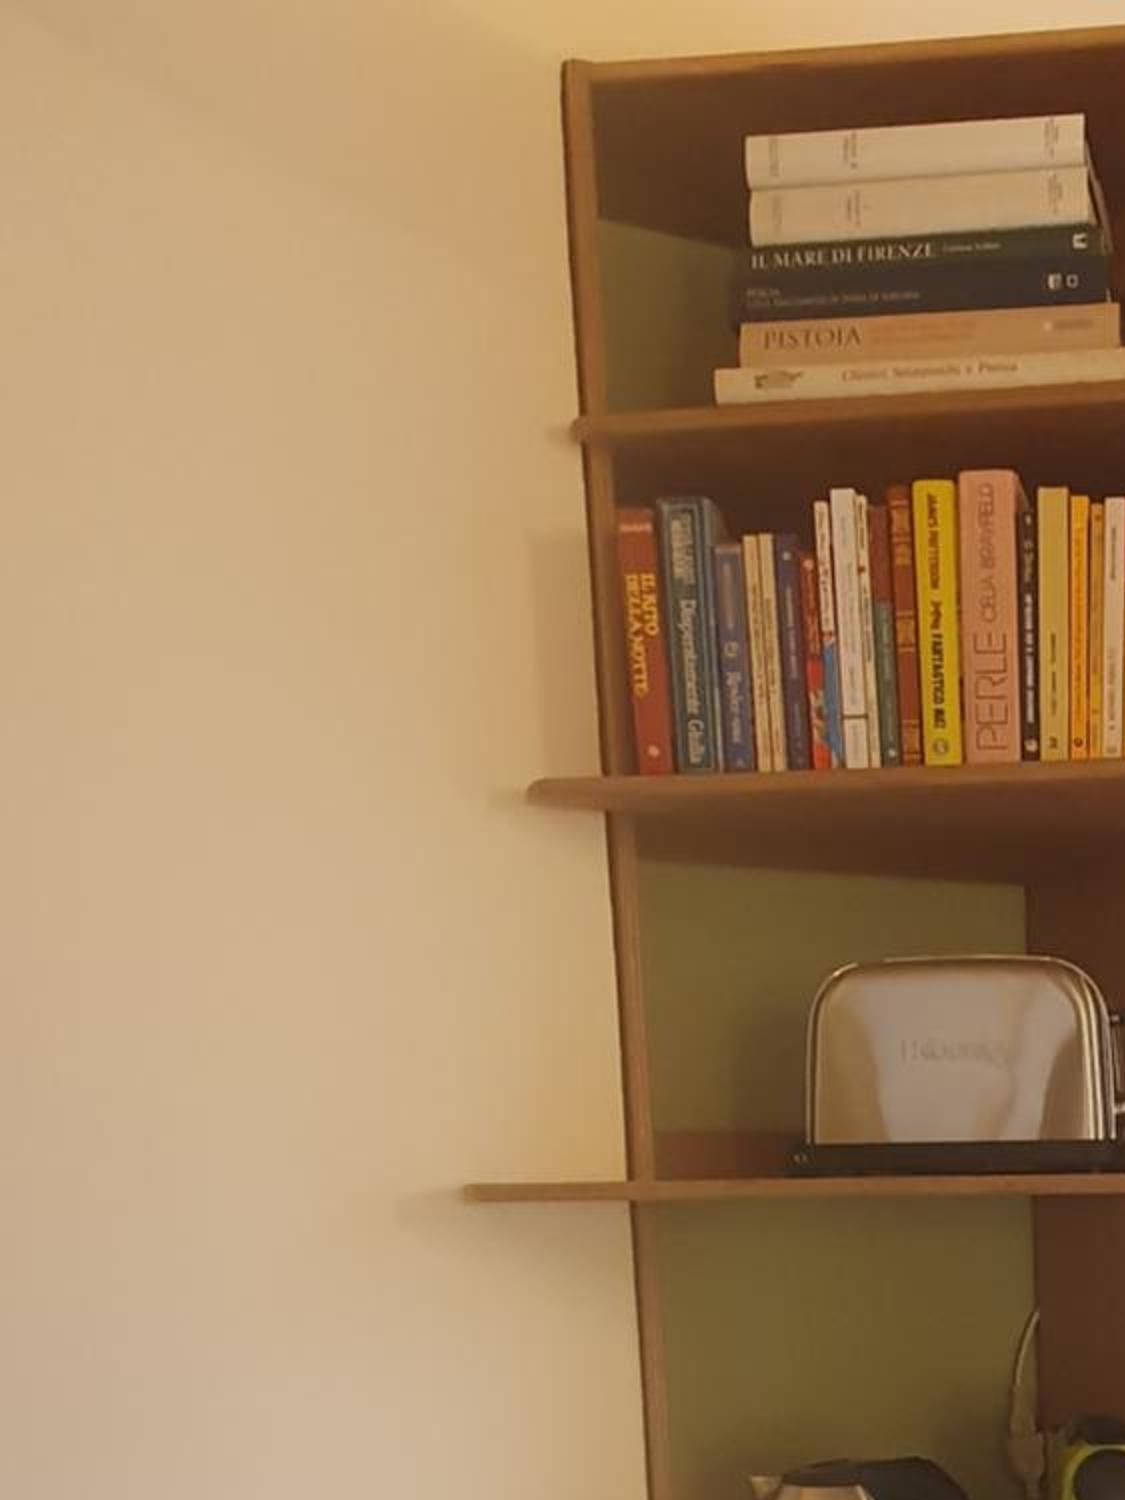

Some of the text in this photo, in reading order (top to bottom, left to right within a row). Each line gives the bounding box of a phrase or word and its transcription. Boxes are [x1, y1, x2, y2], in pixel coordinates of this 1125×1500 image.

[752, 254, 768, 270] IL
[773, 250, 824, 268] MARE
[832, 248, 852, 264] DI
[858, 243, 932, 263] FIRENZE
[764, 326, 863, 350] PISTOIA
[973, 630, 1008, 751] PERLE
